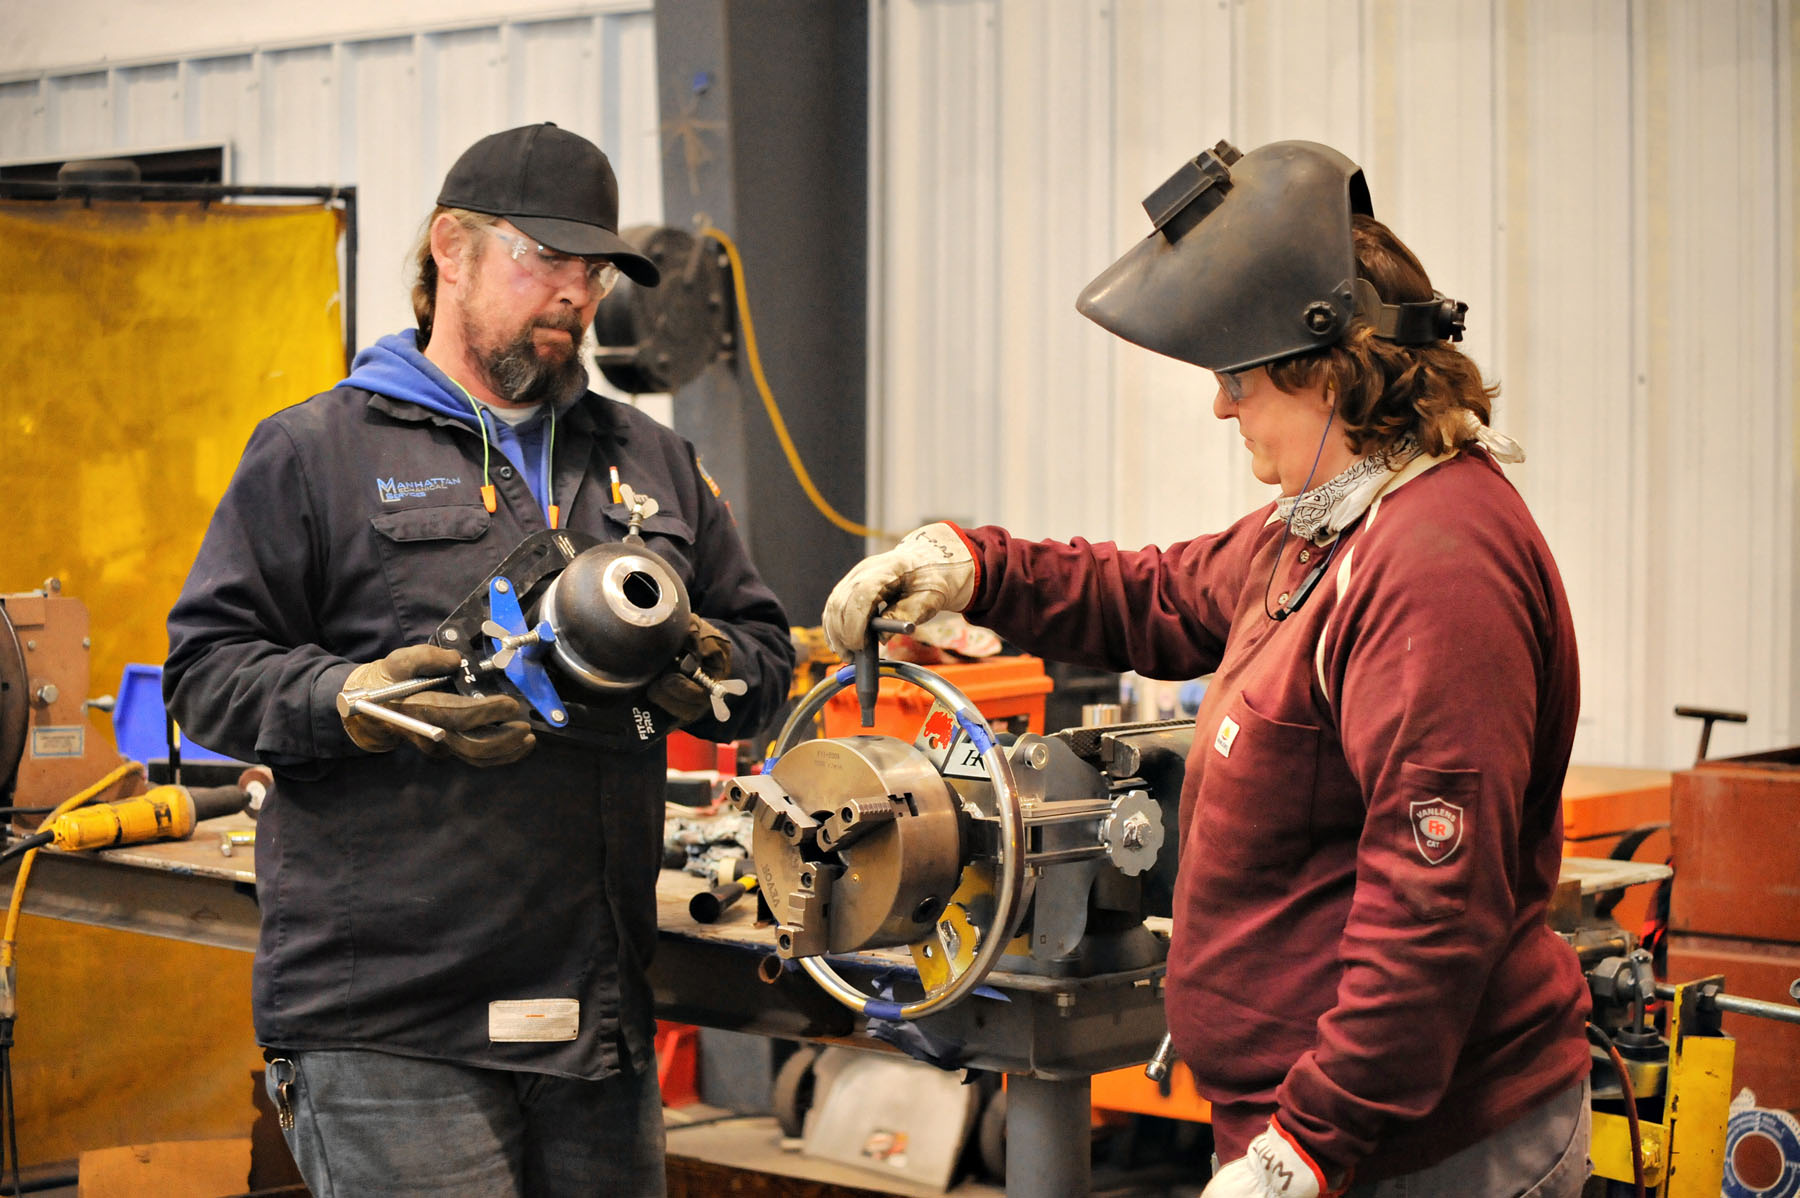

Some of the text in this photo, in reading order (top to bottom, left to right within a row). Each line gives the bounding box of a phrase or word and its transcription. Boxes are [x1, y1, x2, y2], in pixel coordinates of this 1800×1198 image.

[632, 707, 649, 740] FIT-UP
[642, 711, 655, 734] PRO
[1428, 819, 1447, 837] FR
